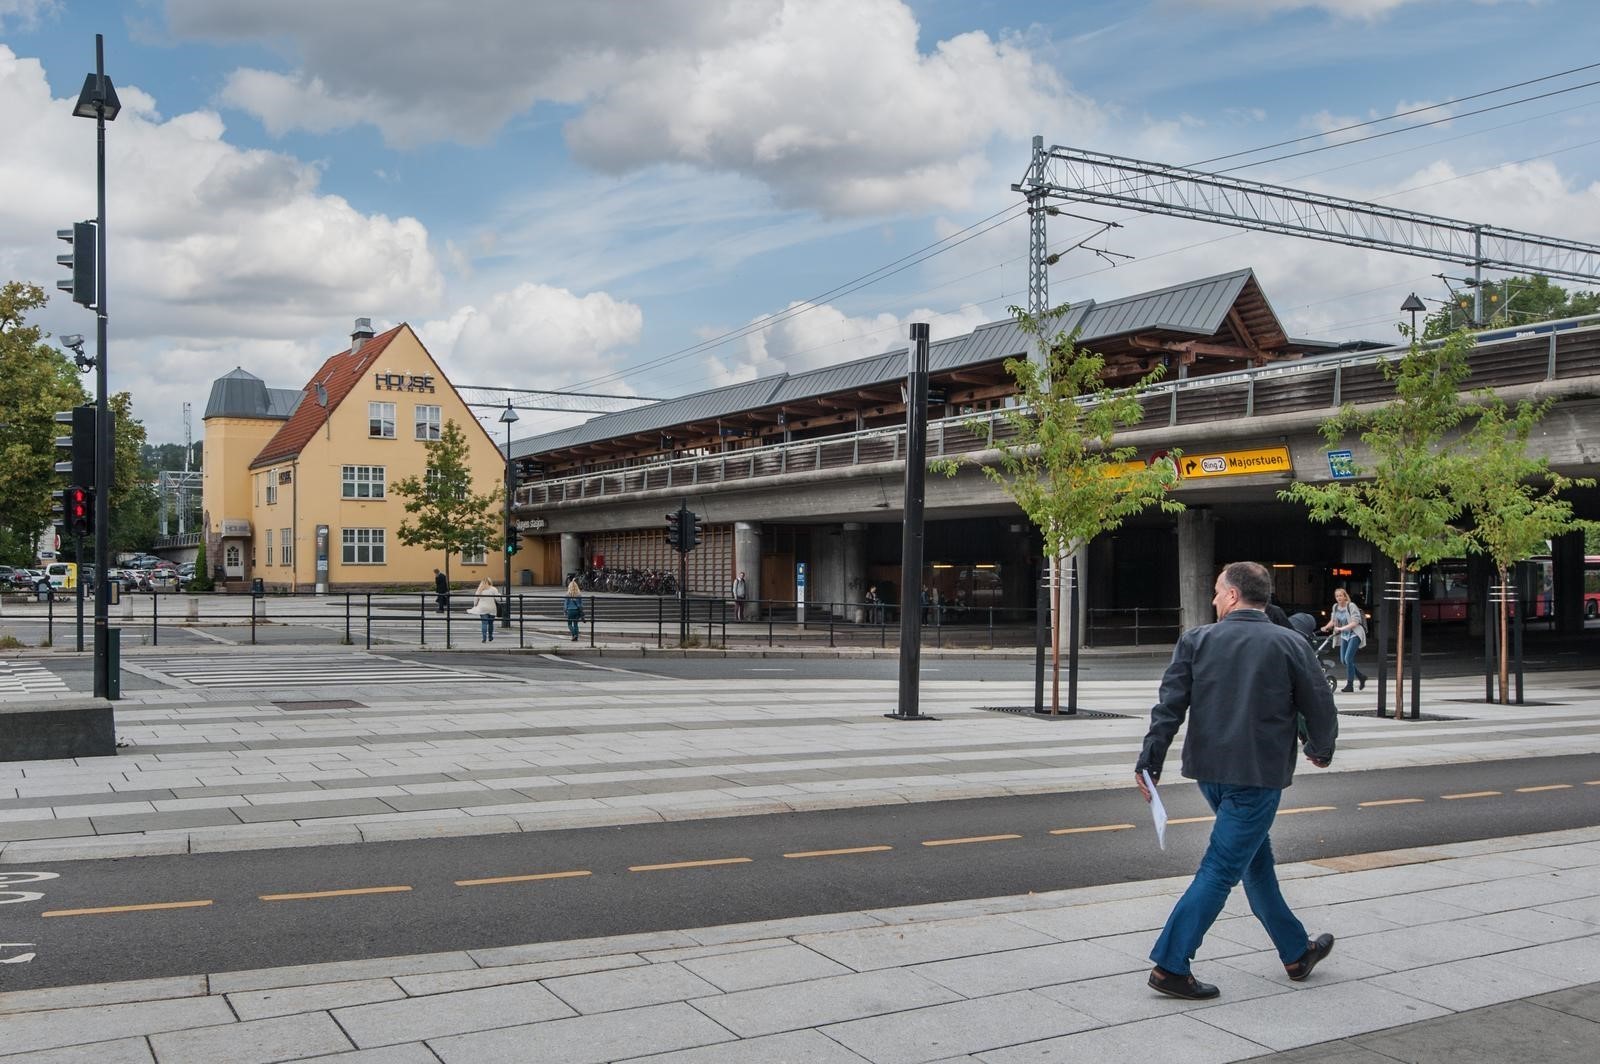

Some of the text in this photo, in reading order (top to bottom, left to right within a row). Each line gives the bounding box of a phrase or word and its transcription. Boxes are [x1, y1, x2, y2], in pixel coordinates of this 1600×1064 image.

[376, 373, 435, 388] HOUSE
[1203, 455, 1283, 470] Ring 2 Majorstuen
